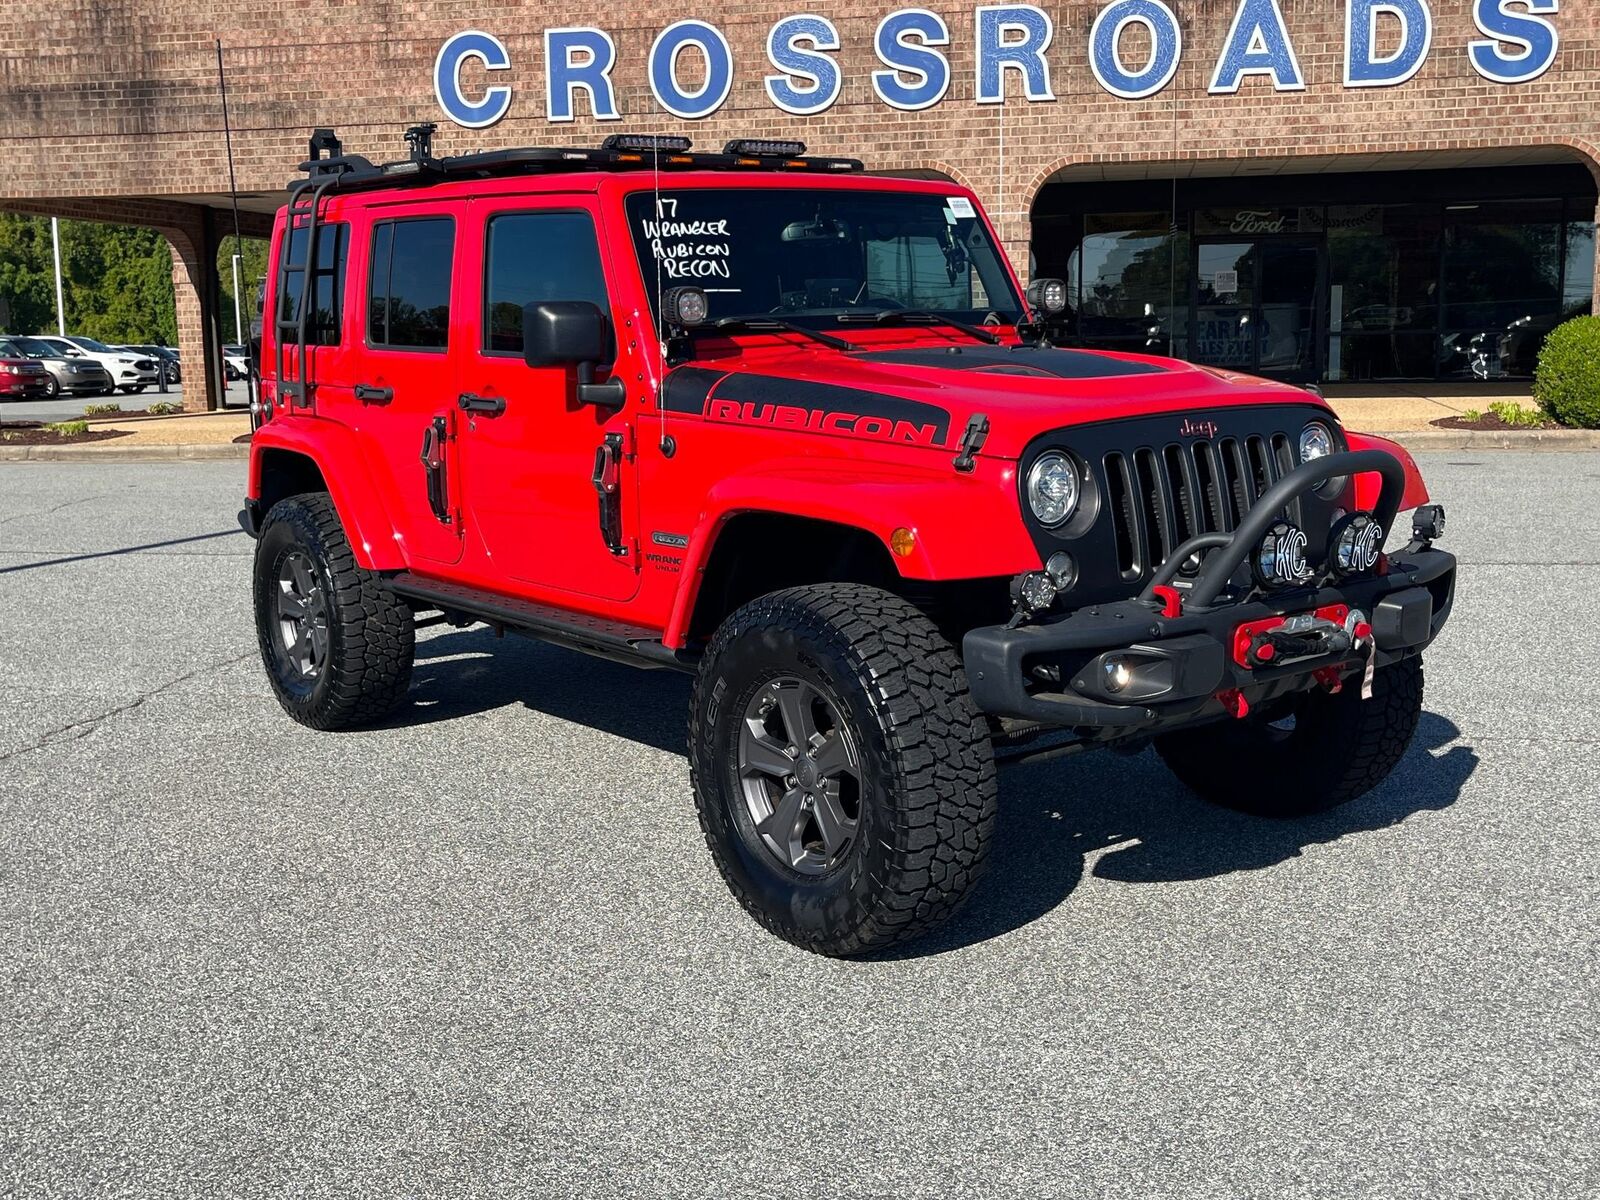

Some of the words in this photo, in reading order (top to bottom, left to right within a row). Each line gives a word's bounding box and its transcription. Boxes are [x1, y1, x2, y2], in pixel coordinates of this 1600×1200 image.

[433, 0, 1559, 128] CROSSROADS
[657, 198, 678, 219] 17
[642, 219, 731, 239] WRANGLER
[1229, 210, 1286, 233] Ford
[663, 258, 730, 279] RECON
[1184, 320, 1230, 340] EAR
[709, 399, 939, 446] RUBICON
[1179, 418, 1218, 439] Jeep
[1276, 528, 1307, 580] KC
[1351, 522, 1382, 571] KC
[646, 554, 682, 565] WRANG
